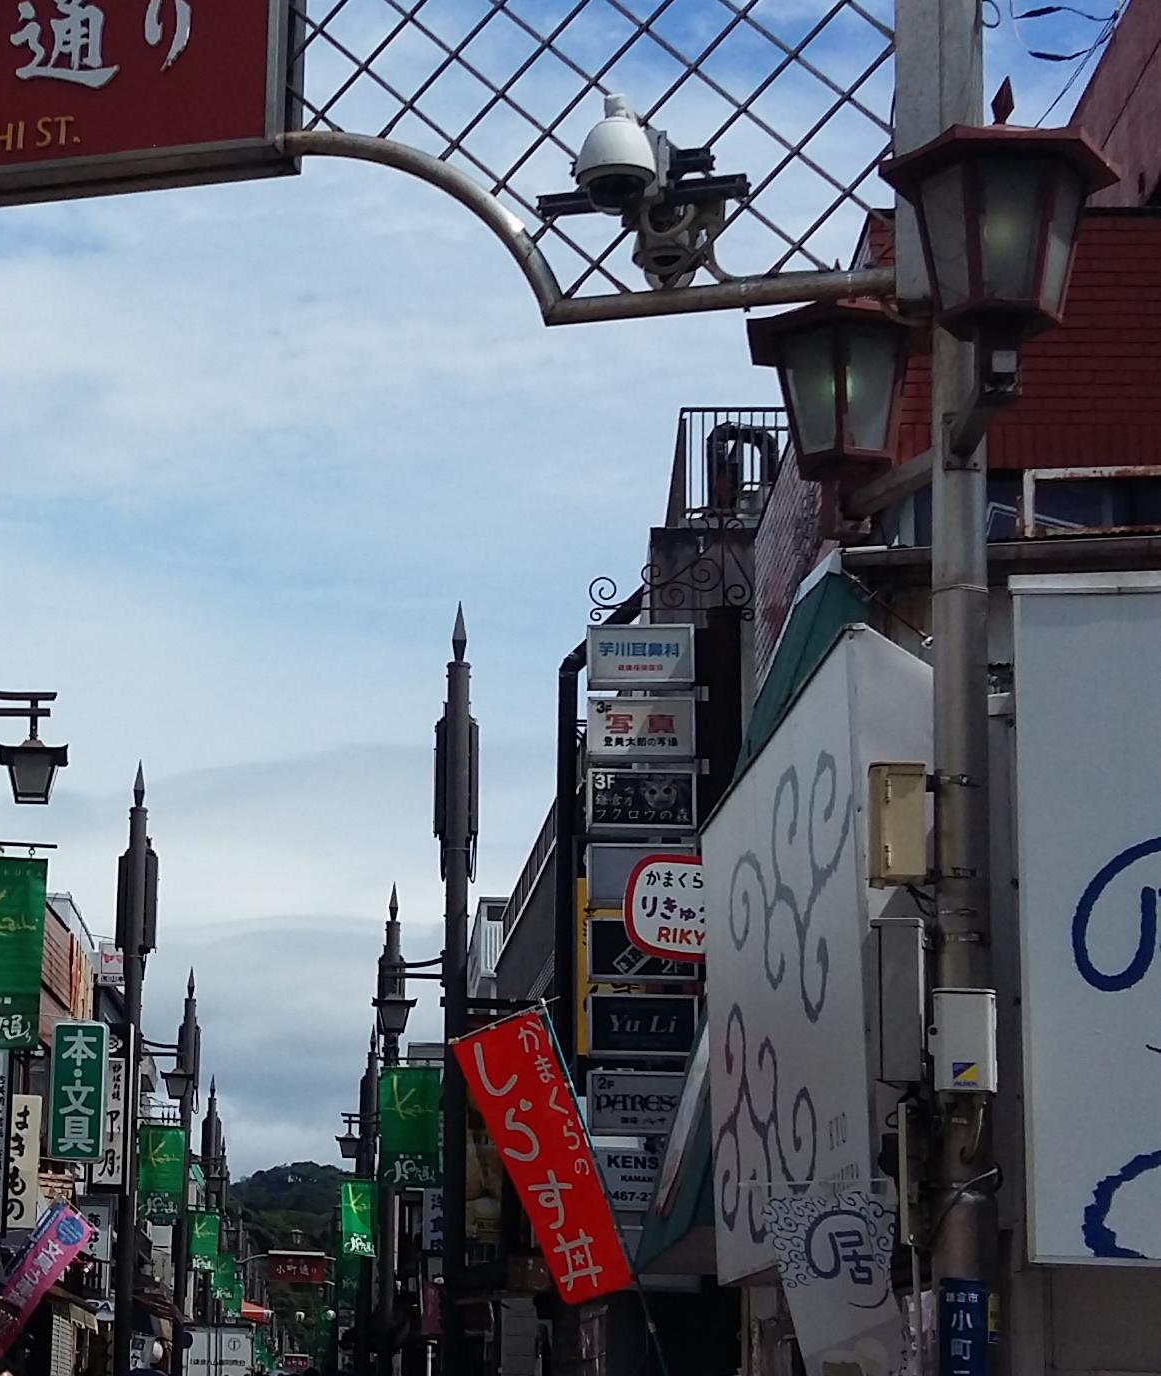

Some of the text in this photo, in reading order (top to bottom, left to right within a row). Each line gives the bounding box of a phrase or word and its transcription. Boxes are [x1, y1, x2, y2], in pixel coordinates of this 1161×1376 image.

[35, 115, 82, 147] ST.
[594, 774, 616, 790] 3F
[645, 870, 704, 889] かまくら
[641, 896, 705, 924] りきゅ
[57, 1029, 98, 1153] 本・文具
[597, 1077, 615, 1090] 2F
[518, 1019, 591, 1176] かまくらの
[621, 1174, 655, 1183] KAMAK
